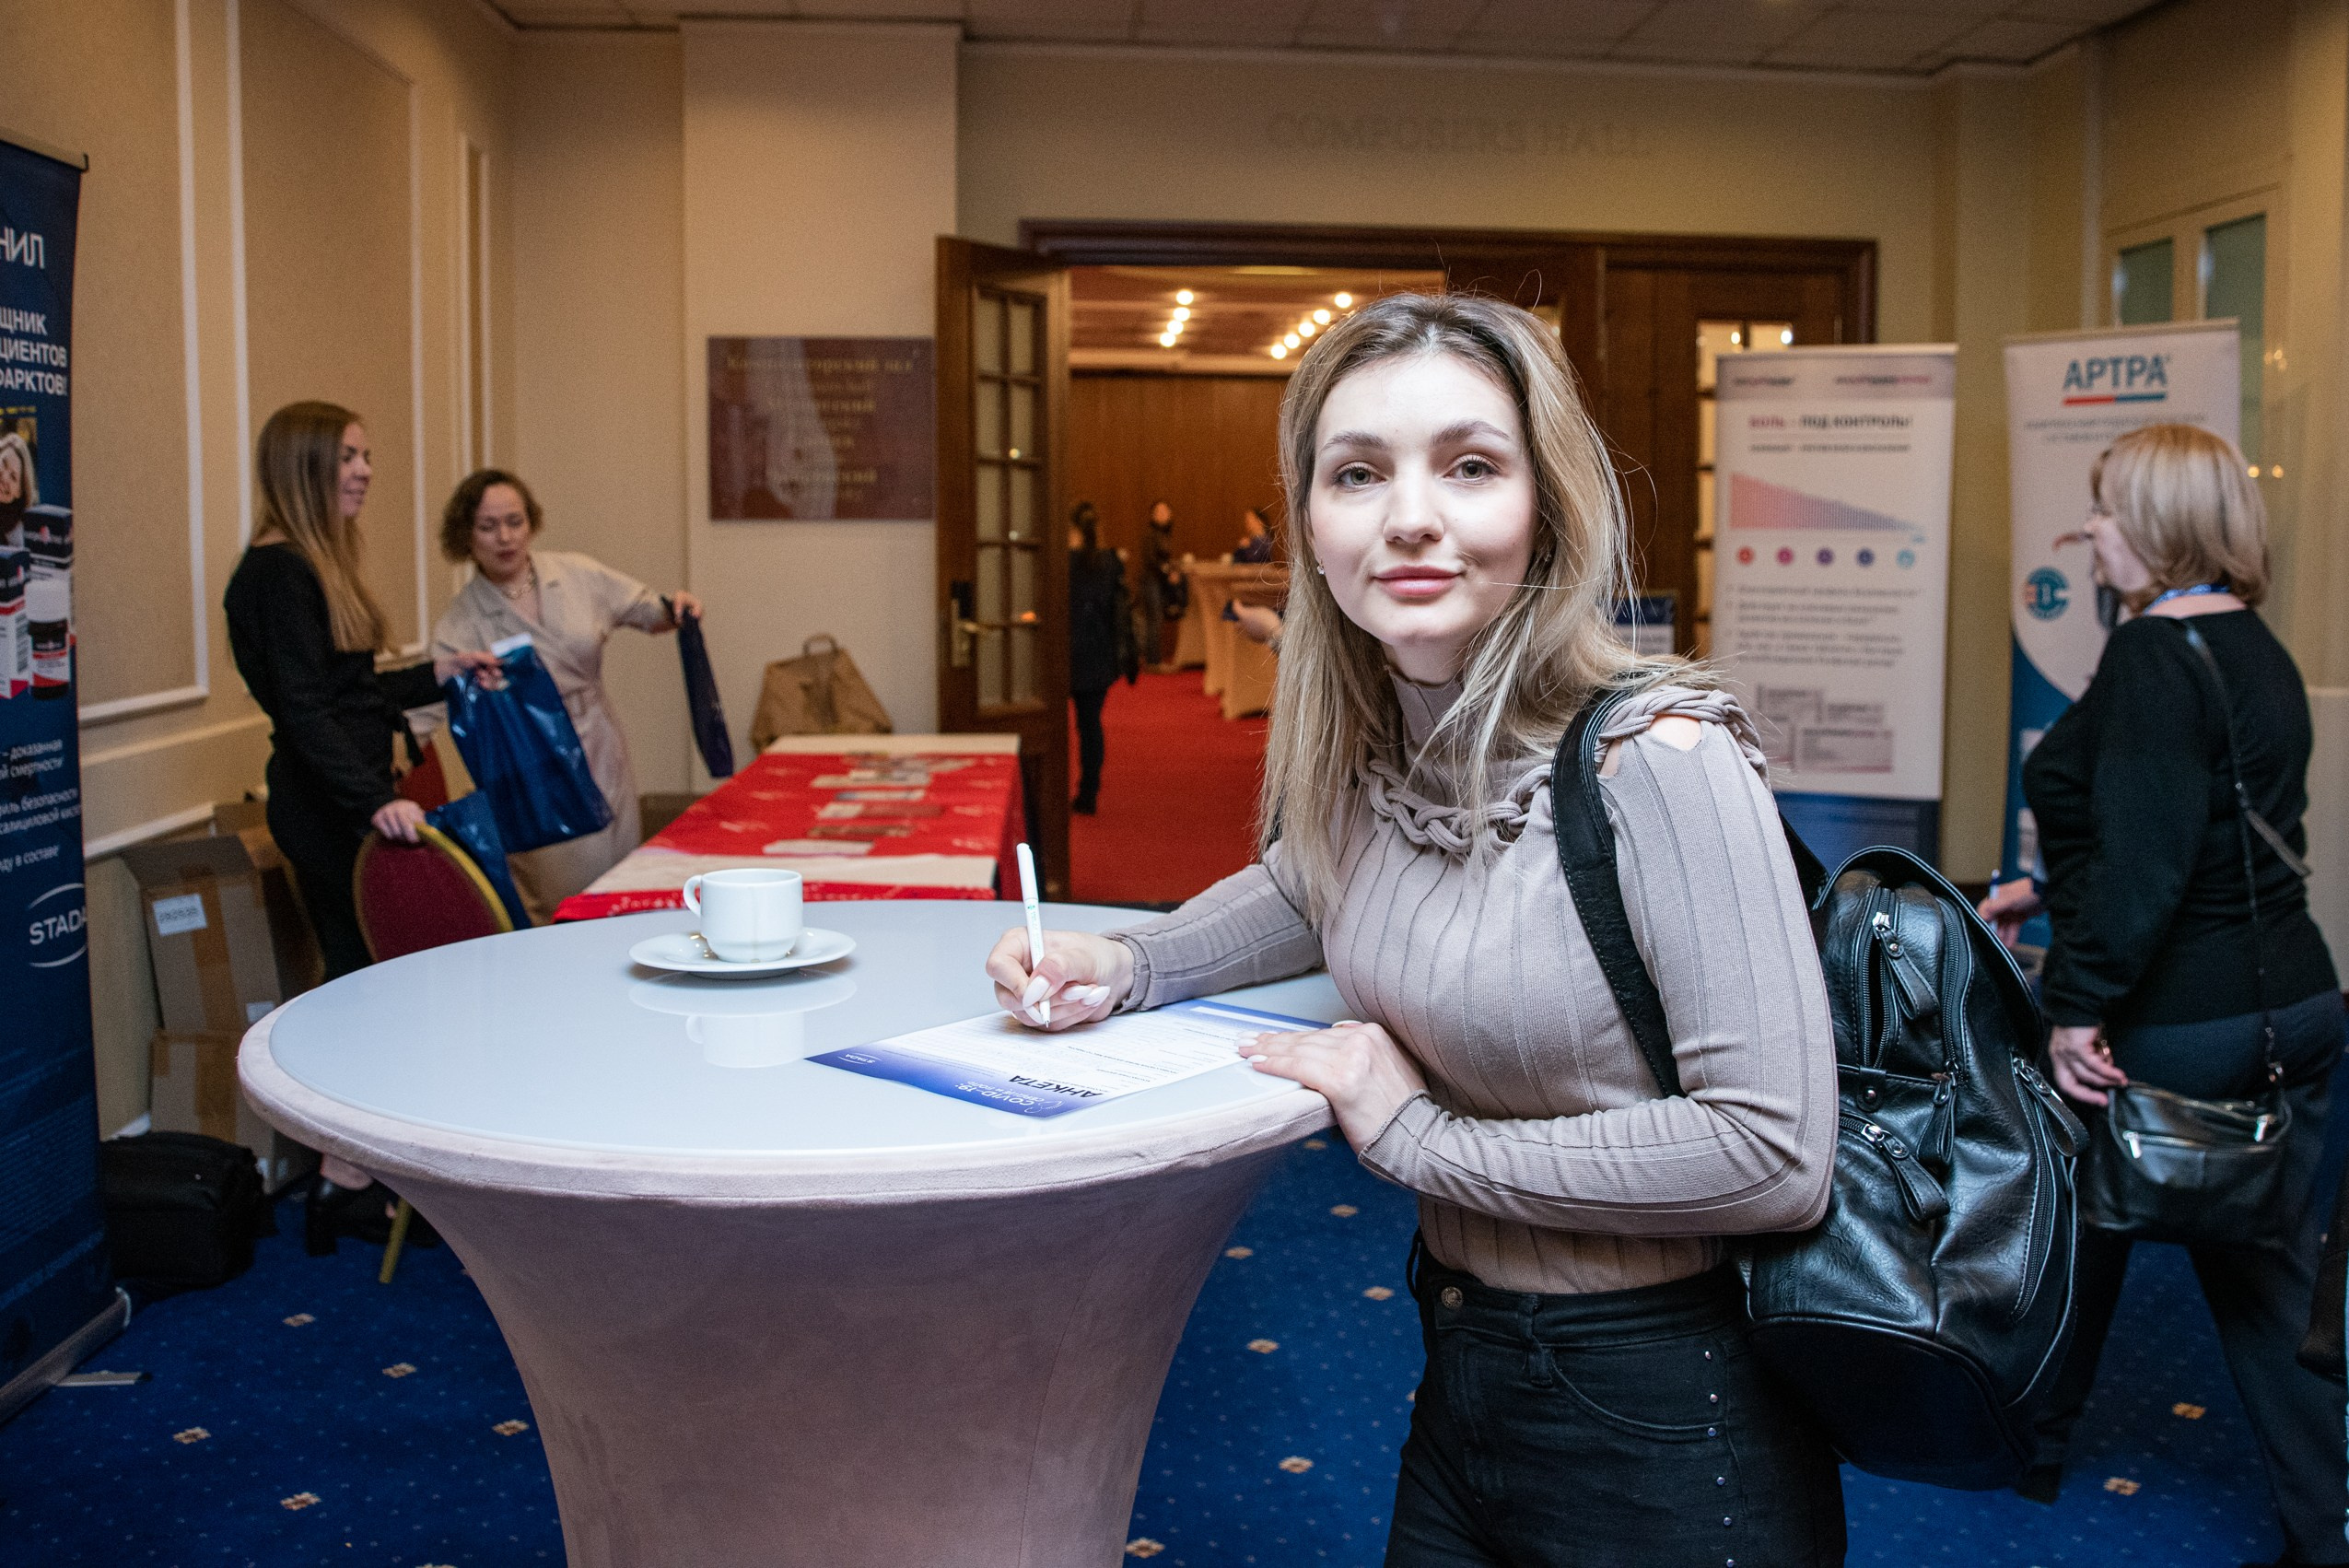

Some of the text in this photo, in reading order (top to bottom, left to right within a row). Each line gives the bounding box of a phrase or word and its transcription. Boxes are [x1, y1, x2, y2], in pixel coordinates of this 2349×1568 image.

[1265, 111, 1653, 158] COMPOSERS HALL
[1009, 1075, 1104, 1098] АНКЕТА
